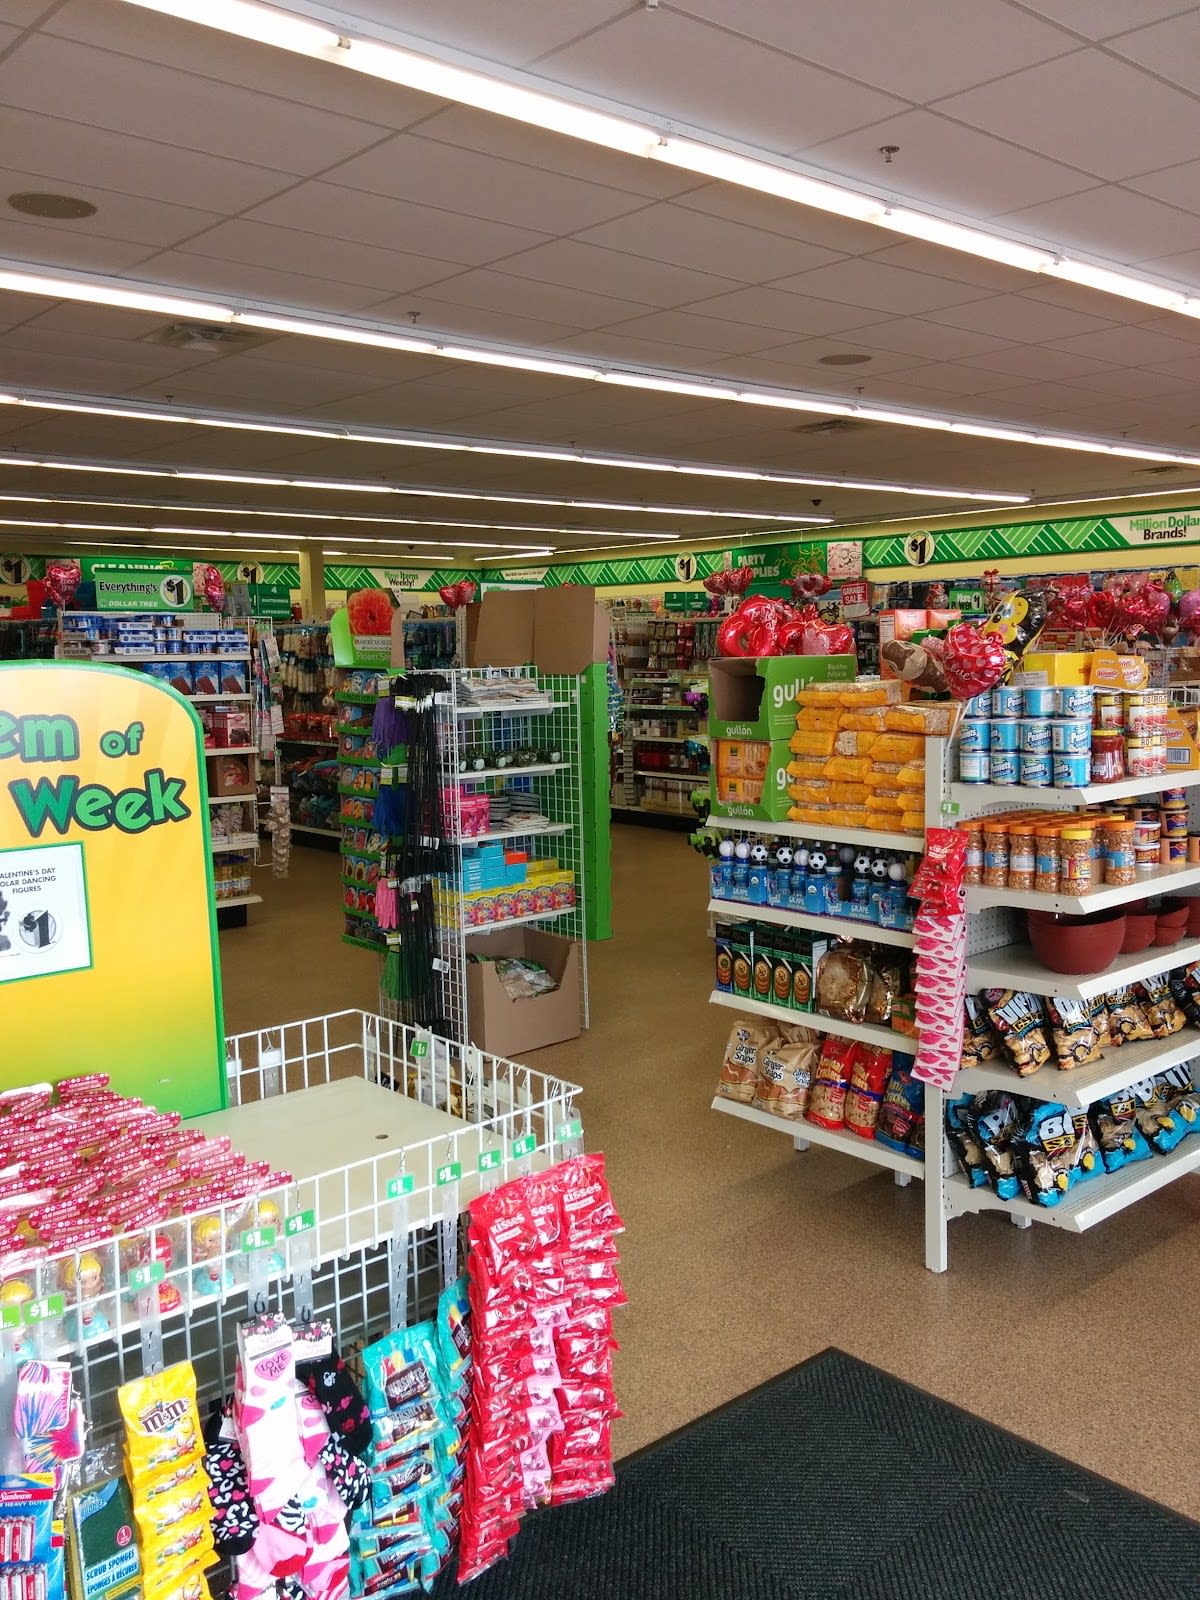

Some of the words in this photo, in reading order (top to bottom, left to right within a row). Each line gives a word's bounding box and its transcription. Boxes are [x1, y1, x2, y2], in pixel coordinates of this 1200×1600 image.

[1129, 518, 1167, 531] Million
[1143, 525, 1187, 541] Brands!
[911, 537, 927, 564] $1
[737, 553, 766, 566] PARTY
[679, 558, 691, 580] $1
[389, 579, 415, 589] Weekly!
[842, 585, 865, 595] GARAGE
[99, 582, 157, 595] Everything's
[166, 579, 185, 605] $1
[845, 595, 864, 604] SALE
[726, 724, 752, 737] gullón
[100, 721, 144, 758] of
[8, 768, 191, 838] Week
[727, 805, 754, 817] gullón
[22, 875, 56, 885] DANCING
[12, 885, 42, 895] FIGURES
[23, 909, 52, 949] $1
[735, 1043, 757, 1055] Ginger
[734, 1052, 755, 1064] Snaps
[763, 1056, 785, 1070] Ginger
[439, 1166, 452, 1181] $1
[289, 1215, 303, 1232] $1
[246, 1231, 260, 1248] $1
[135, 1266, 151, 1284] $1
[30, 1300, 48, 1318] $1
[260, 1353, 287, 1371] LOVE
[269, 1364, 285, 1377] ME
[0, 1489, 33, 1501] Sunbeam
[86, 1564, 107, 1581] SCRUB
[108, 1548, 135, 1570] SPONGES
